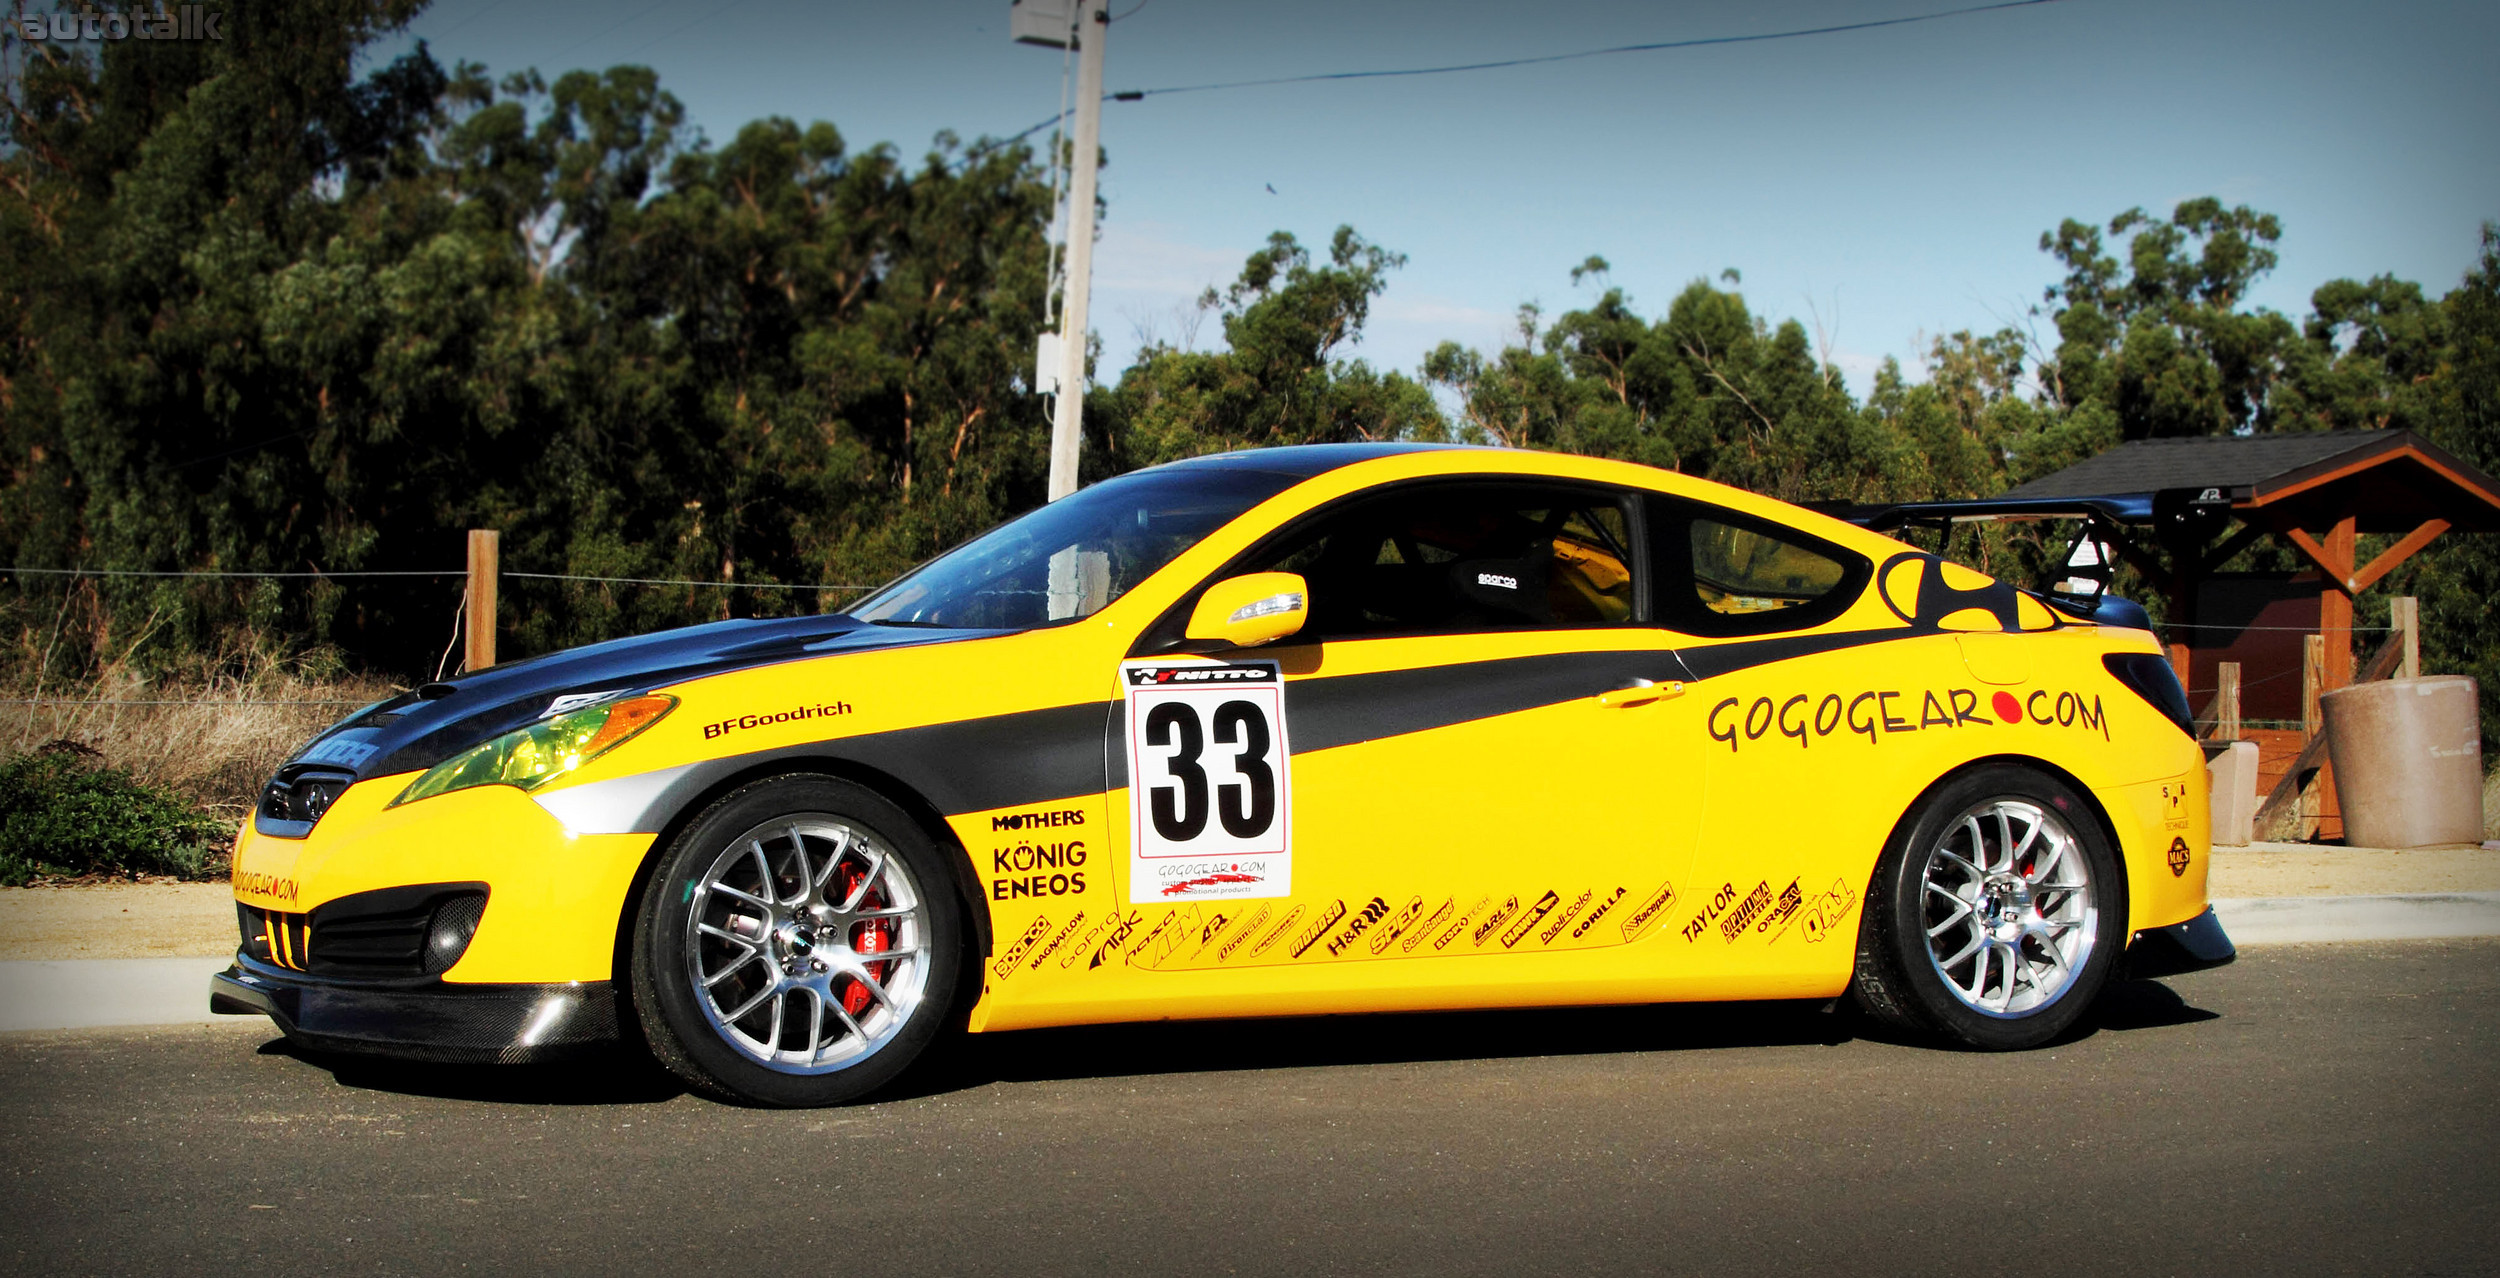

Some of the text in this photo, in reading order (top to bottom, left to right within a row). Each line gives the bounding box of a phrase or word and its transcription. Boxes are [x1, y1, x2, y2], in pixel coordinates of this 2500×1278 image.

[1478, 573, 1517, 588] sparco
[1174, 670, 1268, 681] NITTO
[703, 701, 852, 740] BFGoodrich
[1146, 700, 1276, 842] 33
[992, 809, 1085, 832] MOTHERS
[994, 840, 1087, 873] KÖNIG
[993, 872, 1086, 901] ENEOS
[1220, 886, 1251, 895] products
[1573, 886, 1627, 939] GORILLA
[1633, 889, 1672, 927] Racepak
[1681, 882, 1737, 943] TAYLOR
[1720, 880, 1771, 937] OPTIMA
[1801, 877, 1856, 943] QA1
[1030, 910, 1085, 970] MAGNAFLOW
[1060, 911, 1119, 969] GoPro
[1153, 902, 1203, 969] AEM
[1327, 918, 1368, 956] H&R
[1370, 895, 1424, 955] SPEC
[1502, 907, 1541, 946] HAWK
[1540, 888, 1592, 942] Dupli-Color
[995, 916, 1049, 978] sparco
